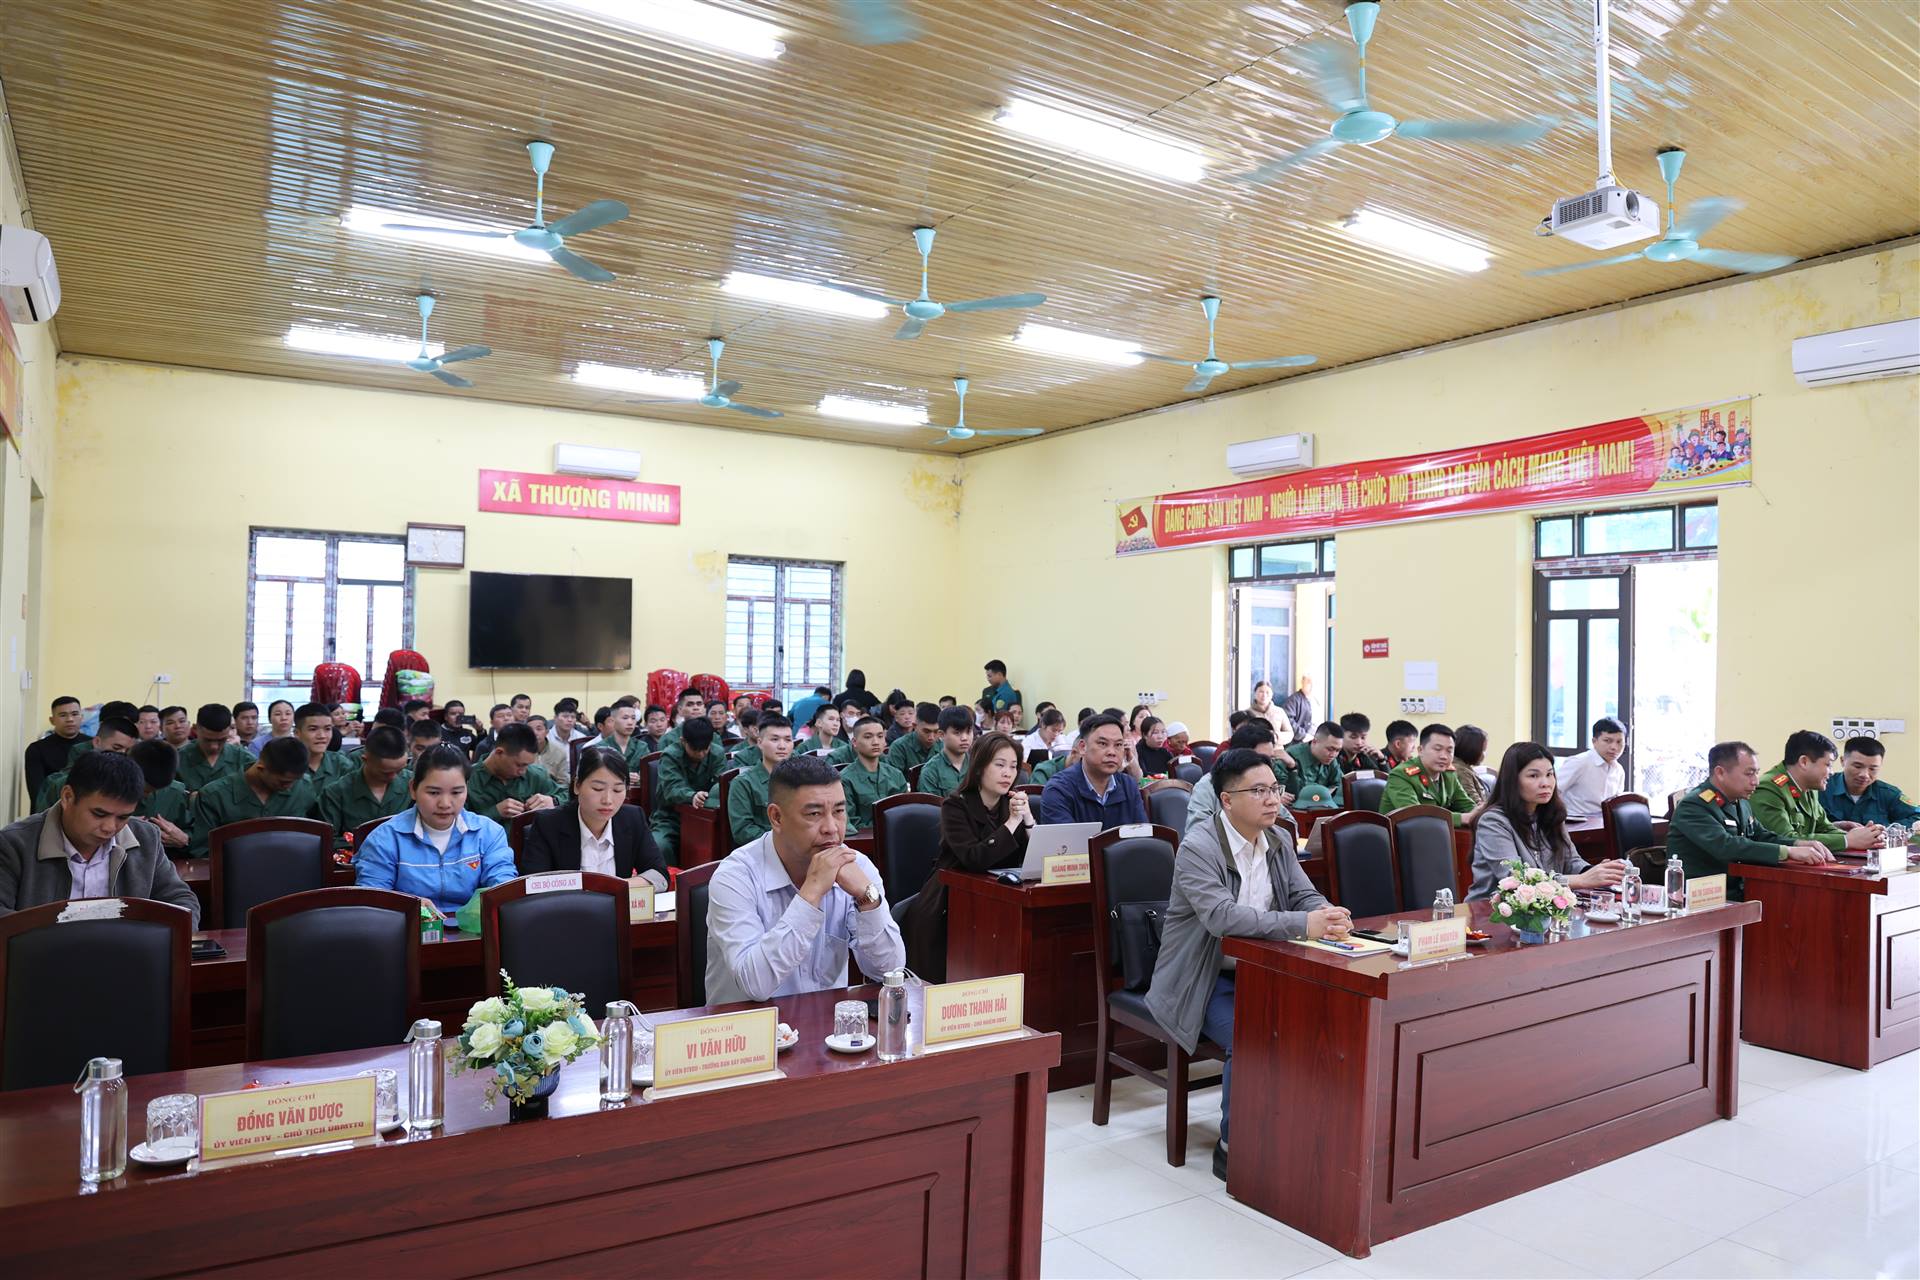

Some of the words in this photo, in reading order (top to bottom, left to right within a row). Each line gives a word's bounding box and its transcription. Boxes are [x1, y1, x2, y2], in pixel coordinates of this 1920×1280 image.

[1243, 496, 1263, 522] NAM
[1270, 484, 1297, 519] NGƯỜI
[1298, 483, 1322, 515] LÃNH
[1346, 470, 1359, 509] TỔ
[1361, 472, 1387, 506] CHỨC
[1389, 473, 1409, 508] MỌI
[1468, 452, 1491, 493] CỦA
[1493, 451, 1525, 490] CÁCH
[1567, 440, 1595, 486] VIỆT
[1598, 440, 1635, 477] NAM!
[492, 479, 522, 503] XÃ
[528, 484, 611, 511] THƯỢNG
[617, 490, 670, 513] MINH
[969, 999, 993, 1016] THANH
[994, 993, 1007, 1011] HẢI
[687, 1043, 697, 1059] VI
[700, 1039, 721, 1057] VĂN
[279, 1106, 305, 1126] VĂN
[309, 1102, 343, 1122] DƯỢC
[229, 1136, 251, 1146] VIÊN
